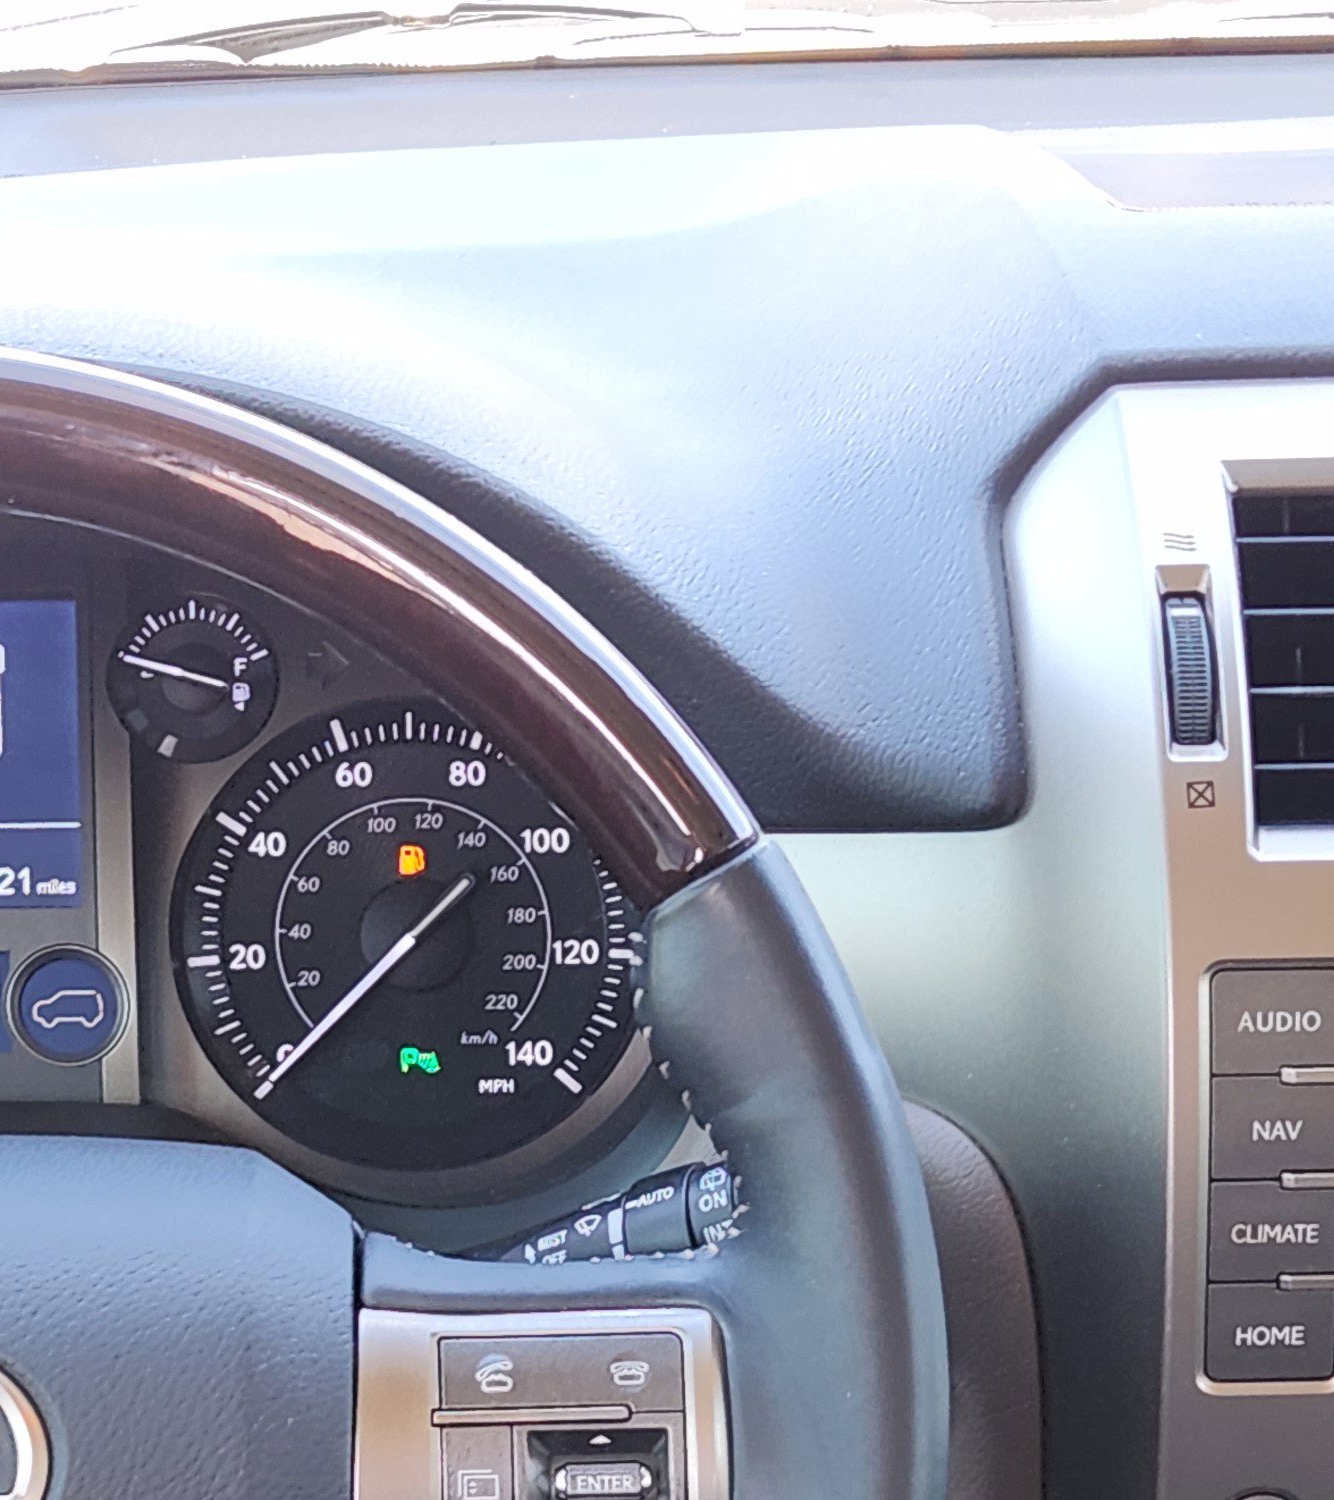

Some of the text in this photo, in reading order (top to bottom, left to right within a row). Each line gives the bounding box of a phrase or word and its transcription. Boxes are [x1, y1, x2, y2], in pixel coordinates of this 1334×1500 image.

[233, 657, 248, 677] F
[334, 762, 372, 788] 60
[449, 761, 486, 786] 80
[367, 816, 396, 833] 100
[415, 813, 443, 830] 120
[248, 831, 286, 857] 40
[326, 839, 350, 855] 80
[457, 831, 486, 849] 140
[522, 828, 569, 854] 100
[297, 875, 320, 893] 60
[490, 866, 519, 883] 160
[36, 877, 77, 896] miles
[507, 906, 536, 924] 180
[287, 923, 311, 940] 40
[229, 945, 265, 971] 20
[503, 954, 536, 971] 200
[553, 940, 599, 966] 120
[297, 969, 320, 987] 20
[485, 994, 518, 1011] 220
[1237, 1011, 1322, 1033] AUDIO
[461, 1029, 498, 1047] km/h
[506, 1040, 553, 1066] 140
[479, 1078, 515, 1094] MPH
[1251, 1120, 1303, 1142] NAV
[636, 1186, 675, 1208] AUTO
[698, 1190, 729, 1213] ON
[1231, 1223, 1320, 1245] CLIMATE
[1235, 1325, 1305, 1347] HOME
[576, 1474, 632, 1492] ENTER
